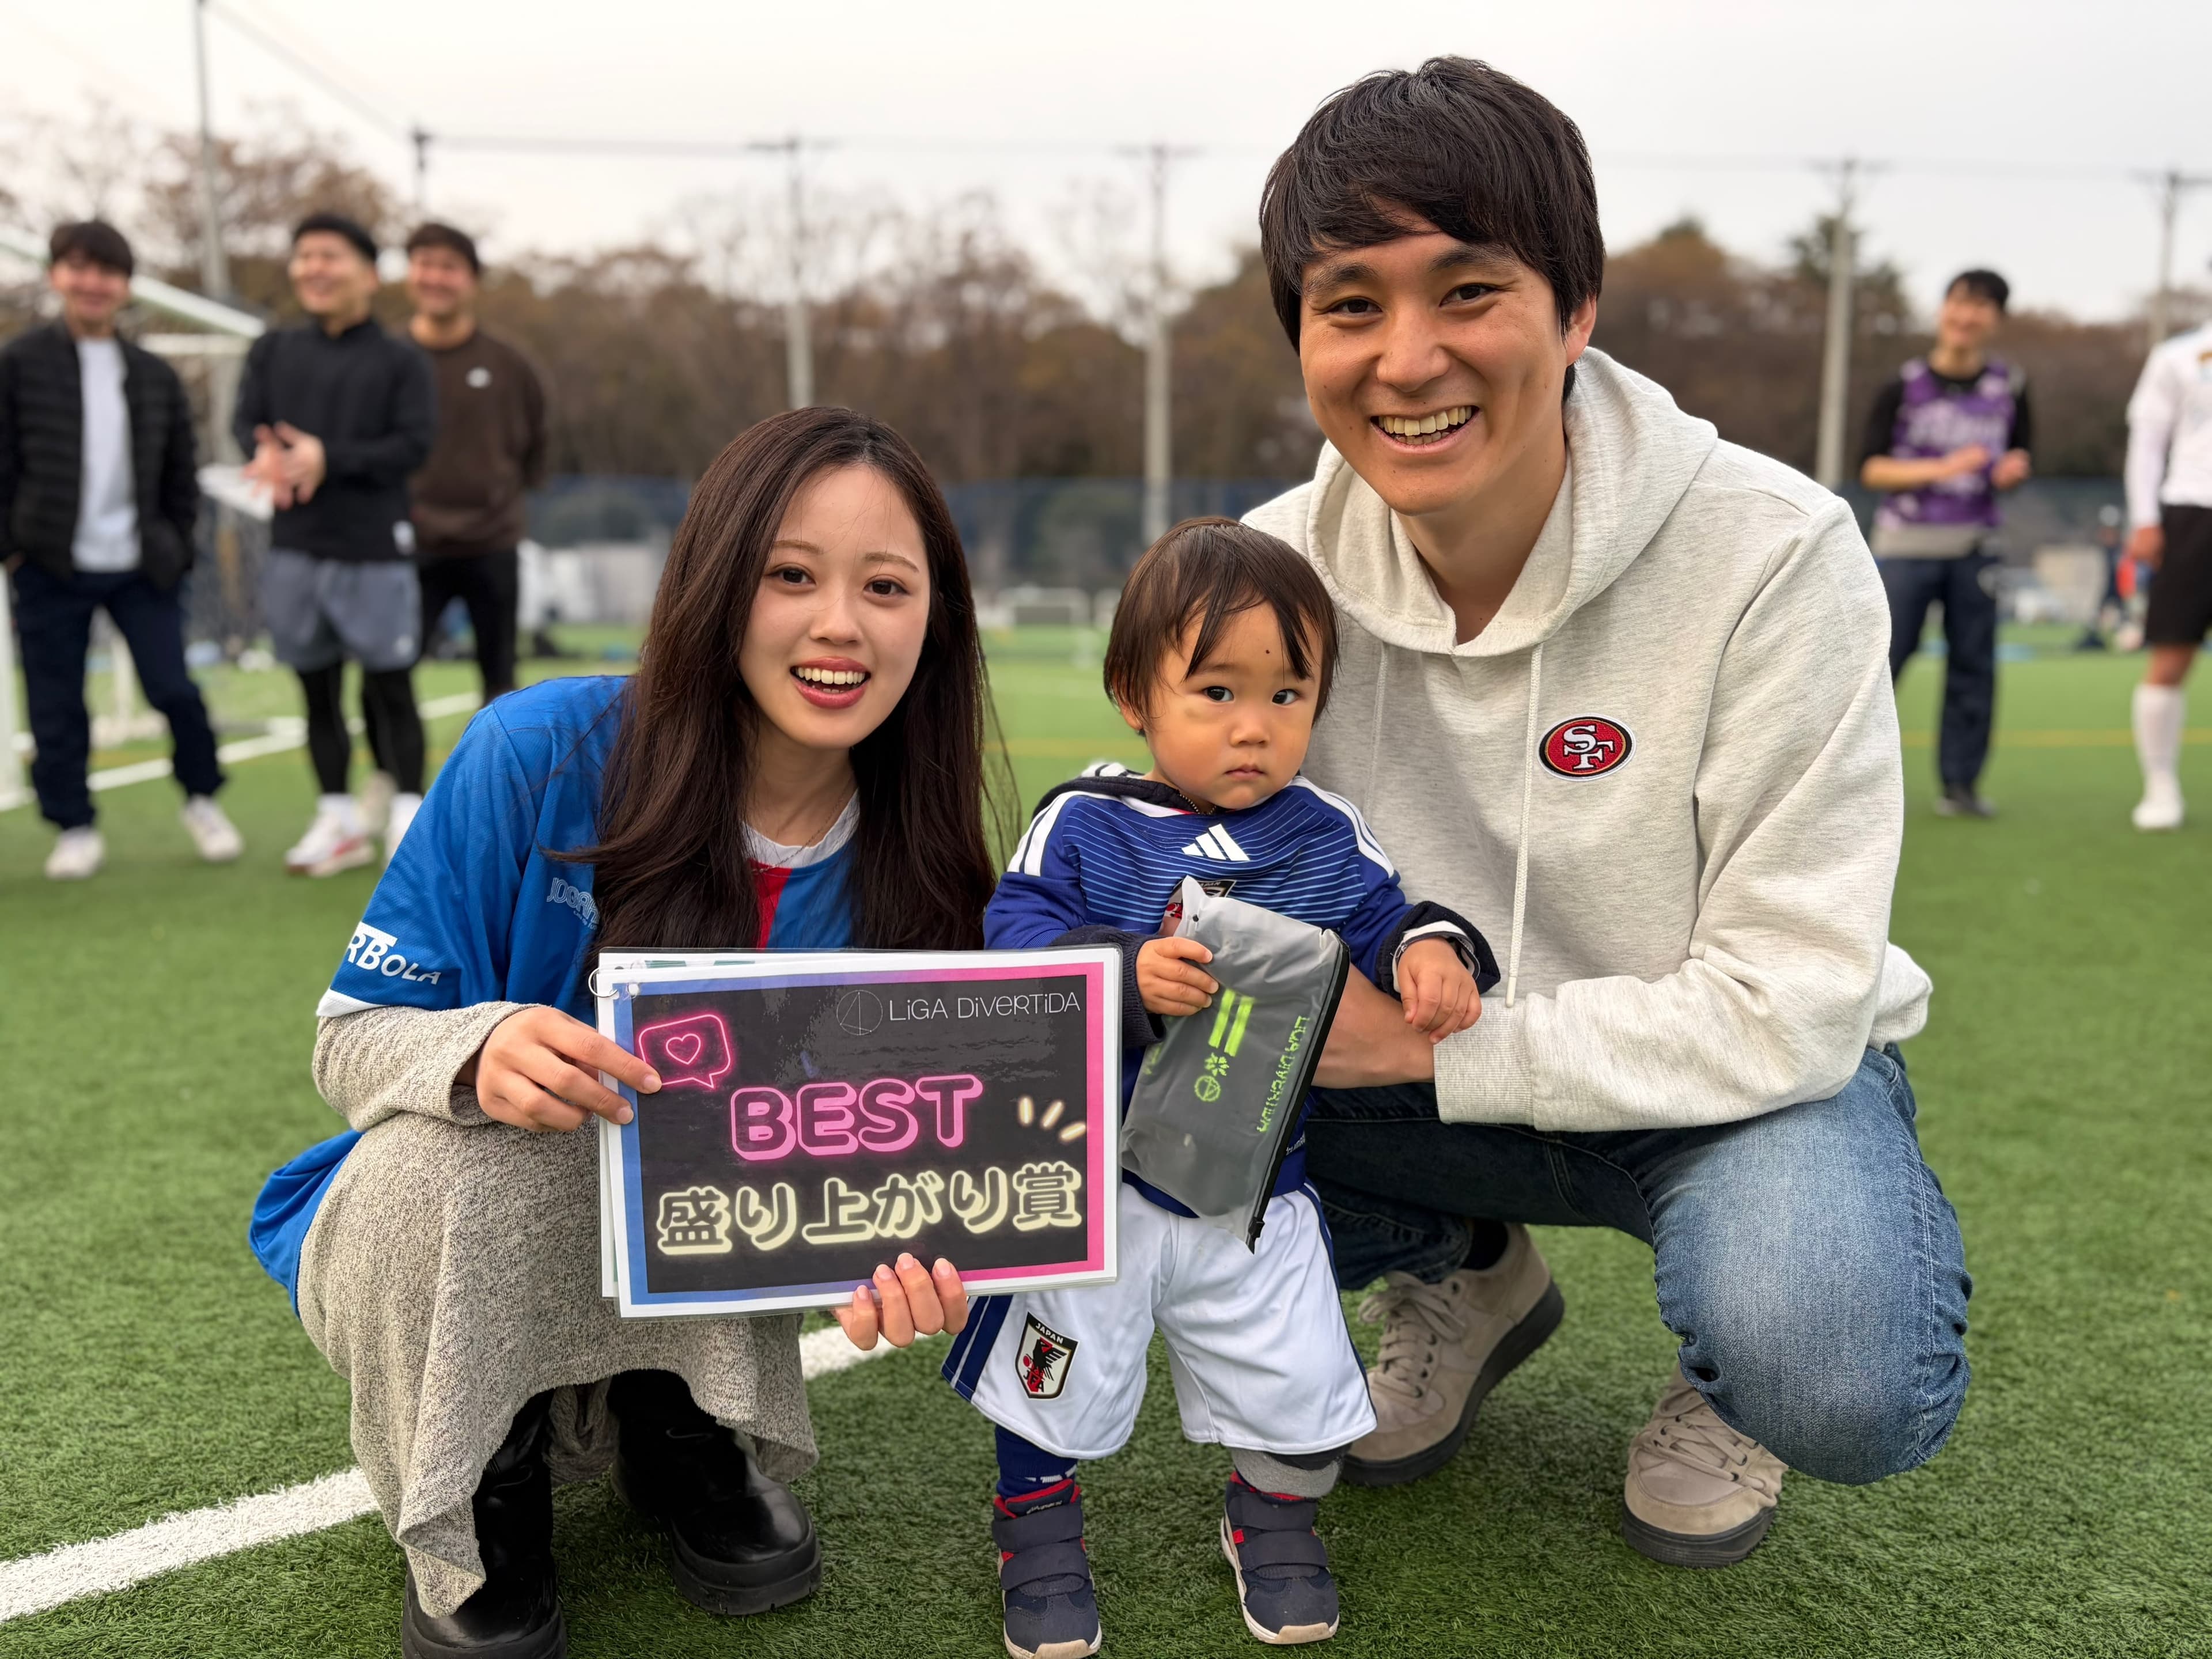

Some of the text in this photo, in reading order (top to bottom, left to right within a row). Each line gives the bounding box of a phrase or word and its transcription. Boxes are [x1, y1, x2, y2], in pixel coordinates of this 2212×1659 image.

[730, 1073, 983, 1161] BEST
[657, 1161, 1082, 1256] 盛り上がり賞
[1035, 1323, 1063, 1344] JAPAN
